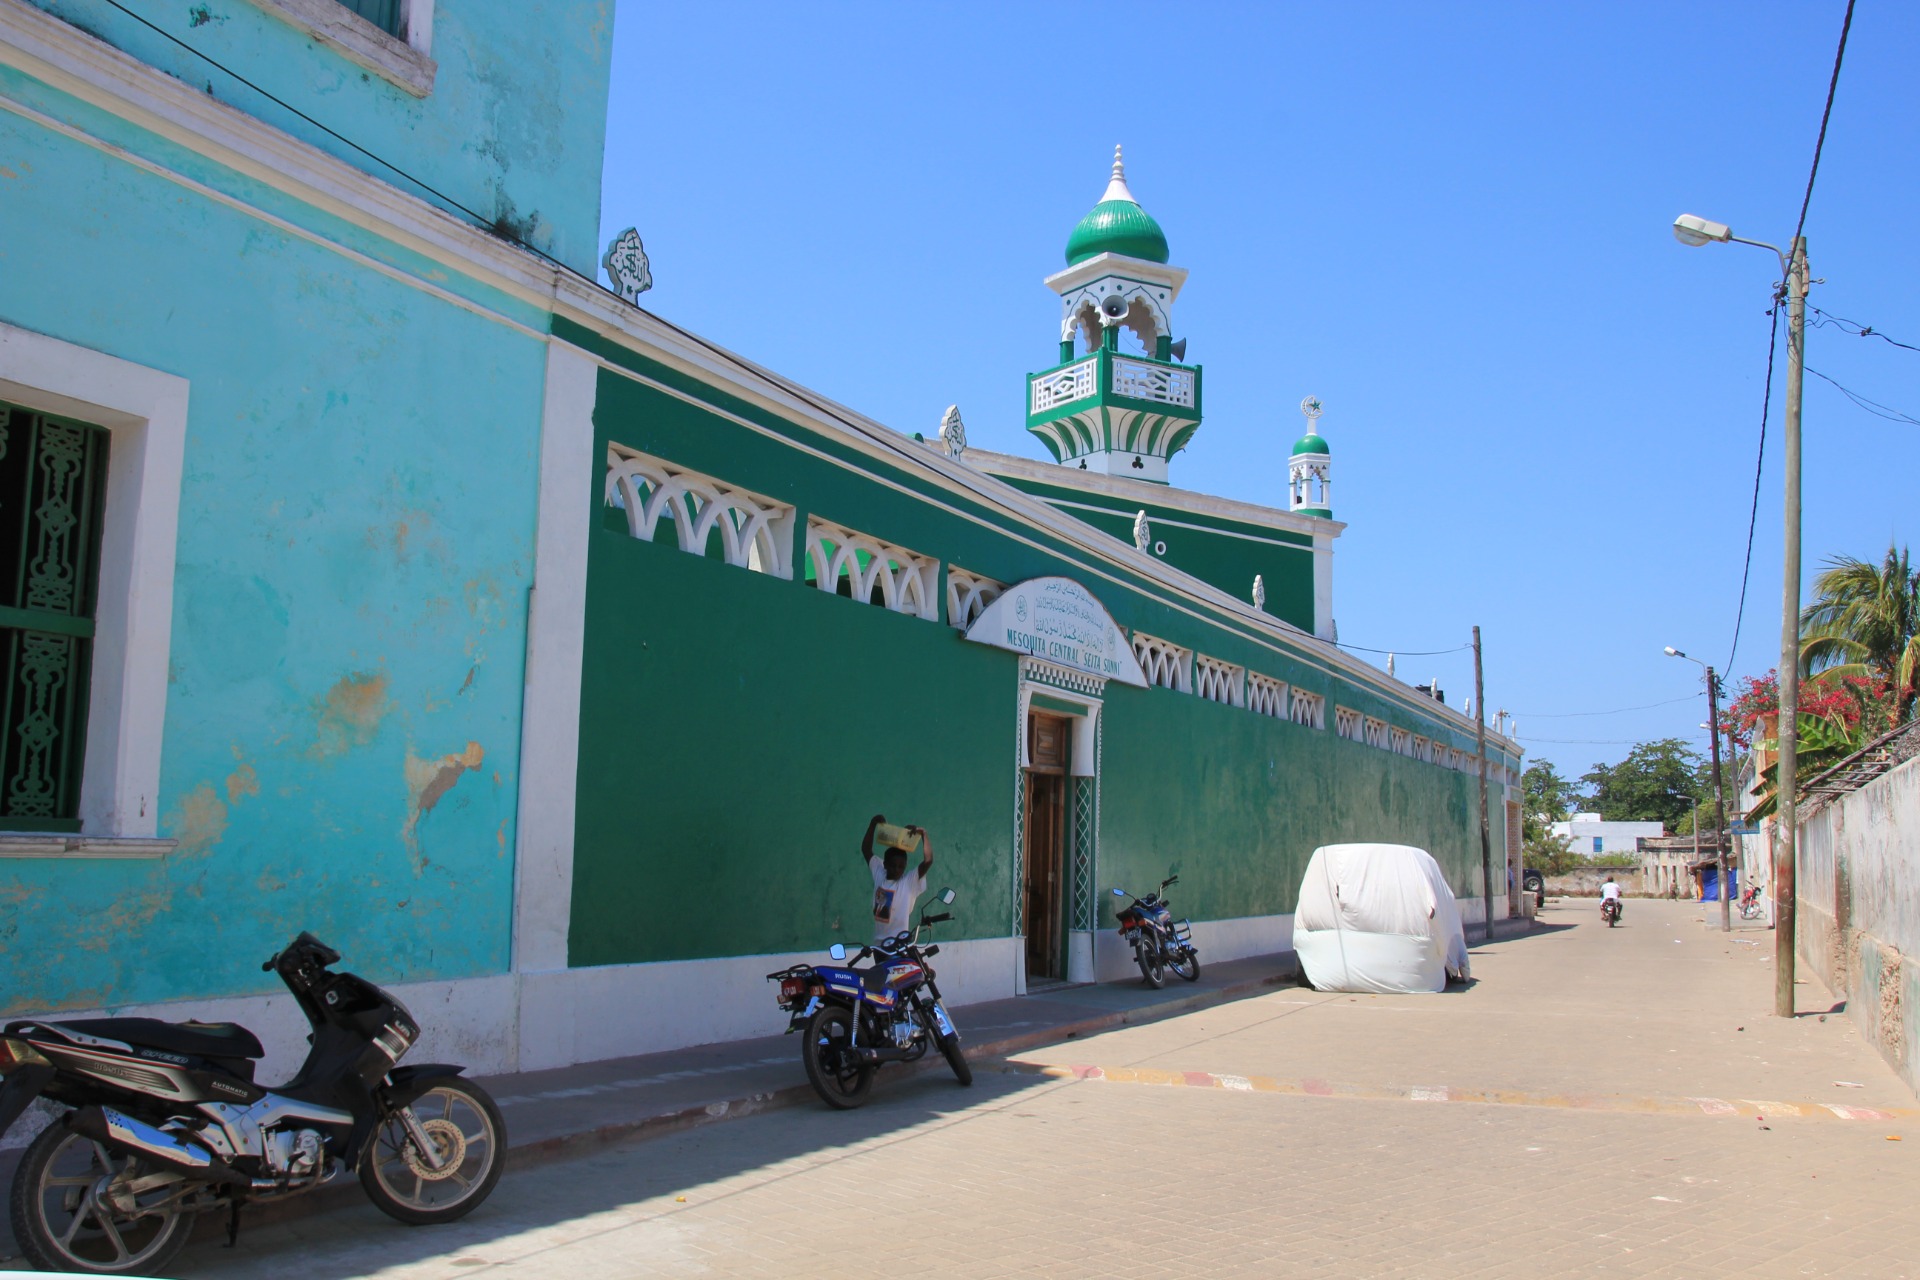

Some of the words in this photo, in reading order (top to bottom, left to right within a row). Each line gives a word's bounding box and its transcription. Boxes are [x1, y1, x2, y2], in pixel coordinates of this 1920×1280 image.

[1007, 628, 1046, 654] MESQUITA
[1049, 641, 1079, 664] CENTRAL
[211, 1080, 249, 1097] AUTOMATIC
